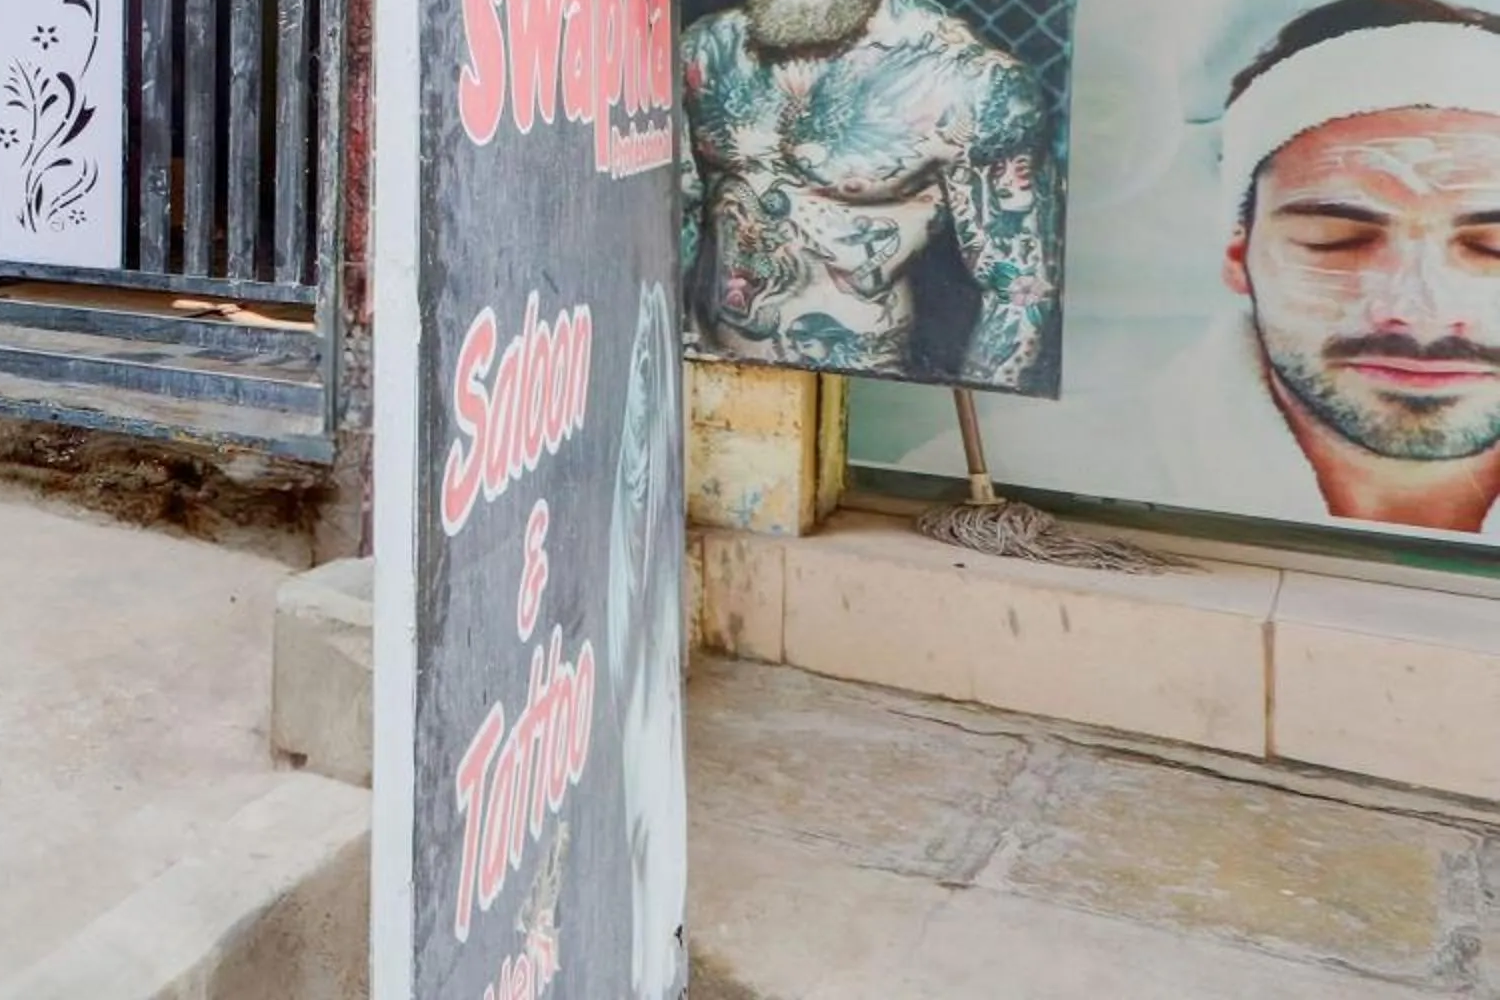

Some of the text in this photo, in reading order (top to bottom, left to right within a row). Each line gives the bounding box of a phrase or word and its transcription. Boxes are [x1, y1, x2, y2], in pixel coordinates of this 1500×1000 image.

[441, 289, 592, 536] Saloon
[517, 499, 549, 641] &
[455, 624, 595, 942] Tattoo
